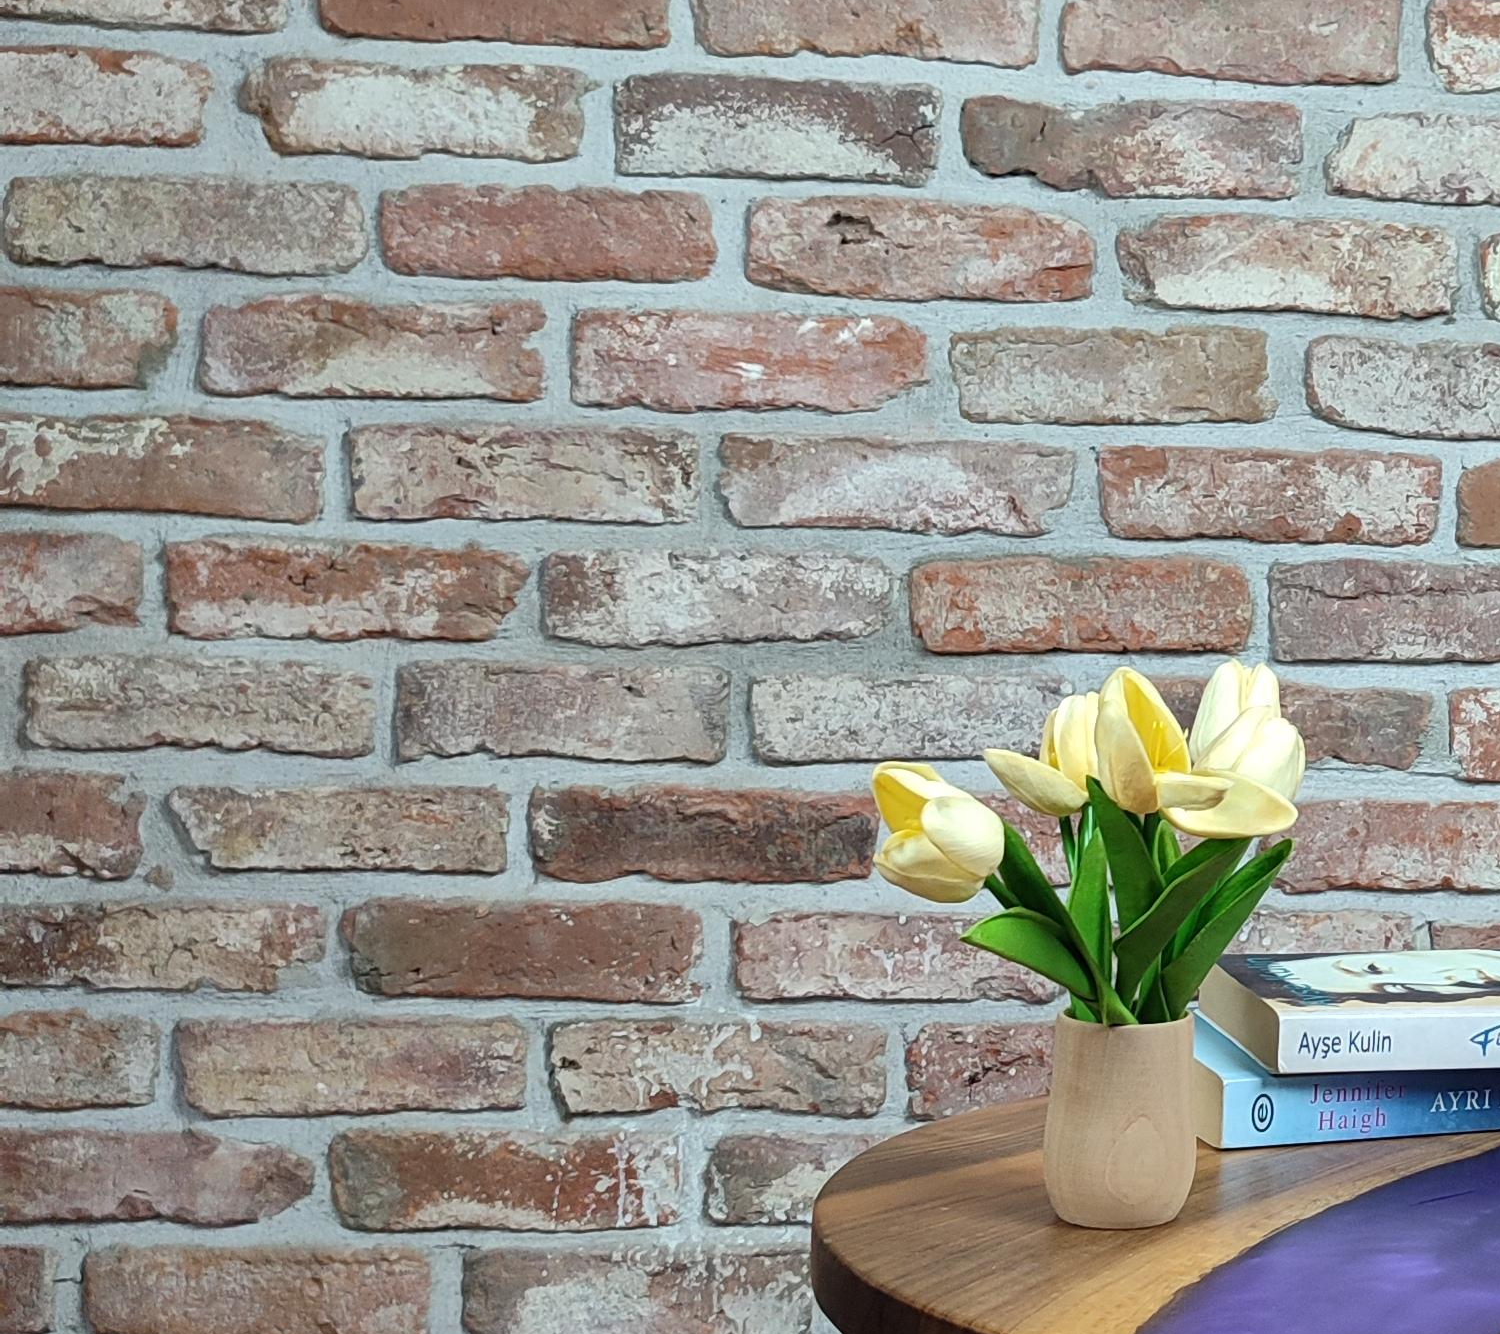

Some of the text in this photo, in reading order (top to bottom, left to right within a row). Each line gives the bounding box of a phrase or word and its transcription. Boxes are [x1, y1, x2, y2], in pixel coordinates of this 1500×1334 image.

[1298, 1029, 1392, 1059] Ayşe Kulin
[1310, 1079, 1407, 1104] Jennifer
[1429, 1088, 1491, 1113] AYRI
[1317, 1107, 1387, 1134] Haigh
